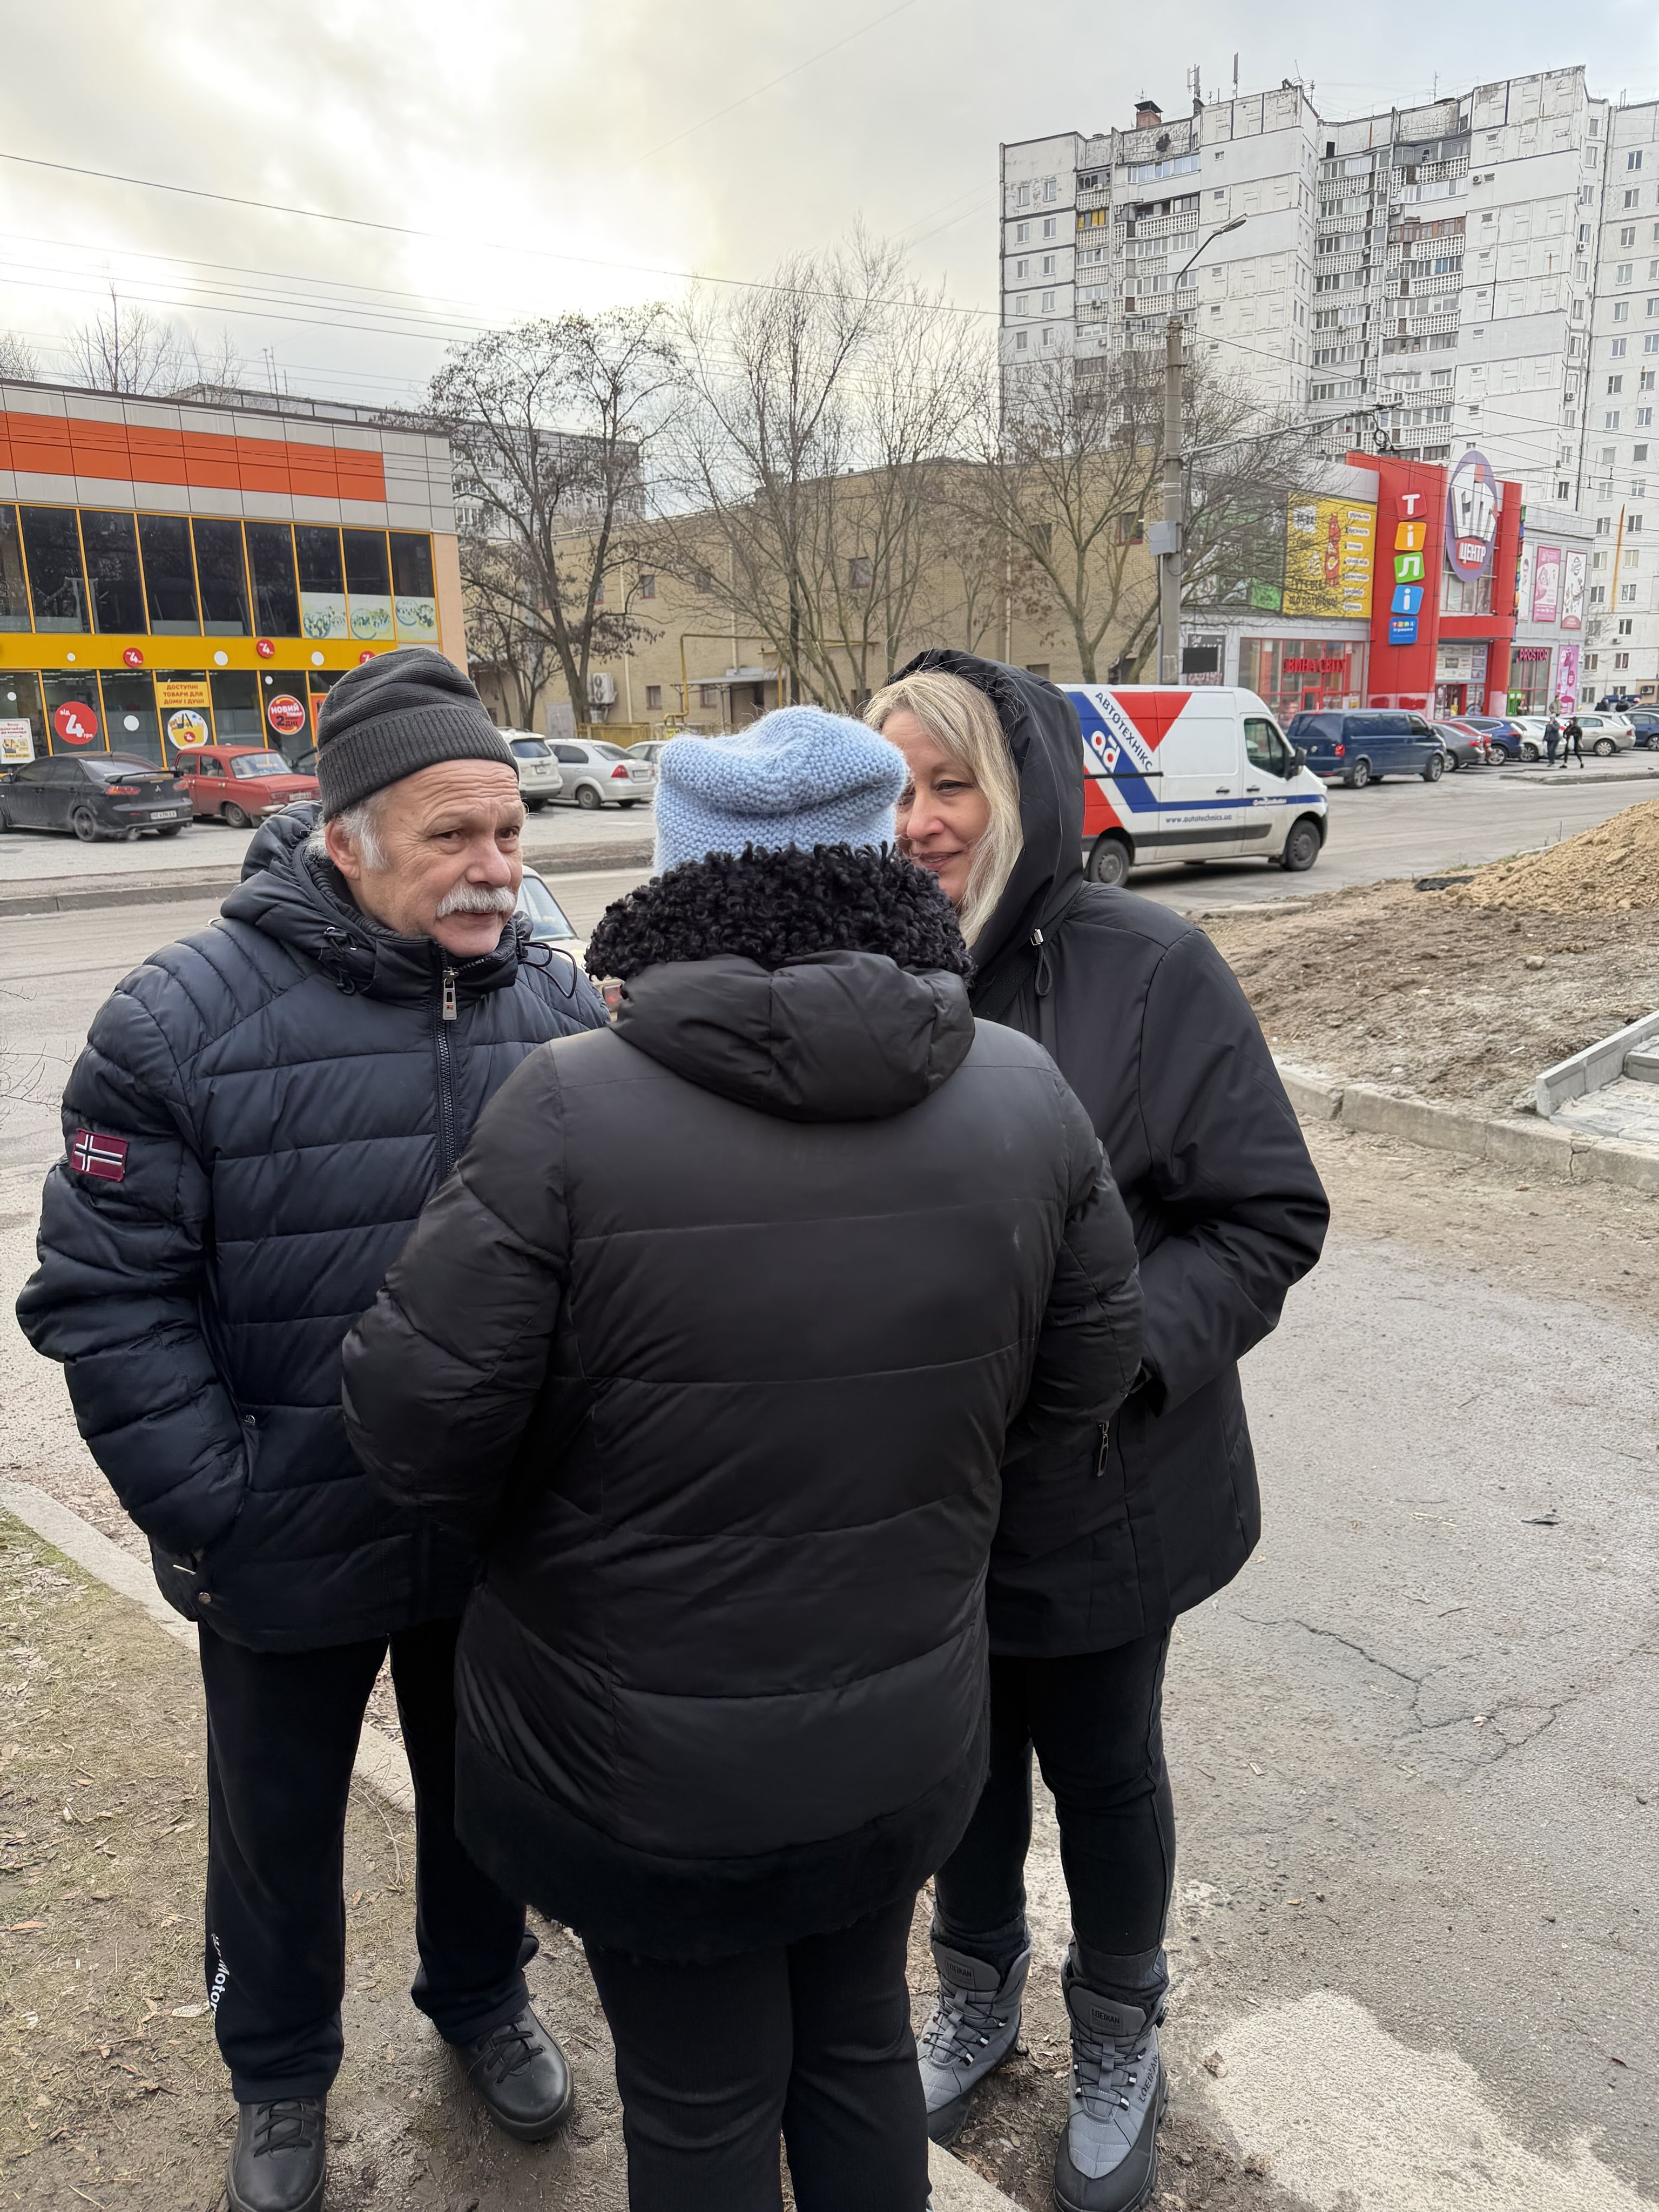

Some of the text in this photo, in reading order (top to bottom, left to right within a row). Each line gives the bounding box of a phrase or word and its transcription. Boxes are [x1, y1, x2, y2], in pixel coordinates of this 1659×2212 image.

[1459, 542, 1486, 564] ЦЕНТР
[1519, 649, 1547, 661] PROSTOR
[271, 703, 299, 714] НОВИЙ
[66, 714, 84, 738] 4
[276, 715, 285, 726] 2
[1095, 692, 1152, 771] АВТОТЕХНІКС
[1166, 814, 1232, 823] www.autotechnics.ua
